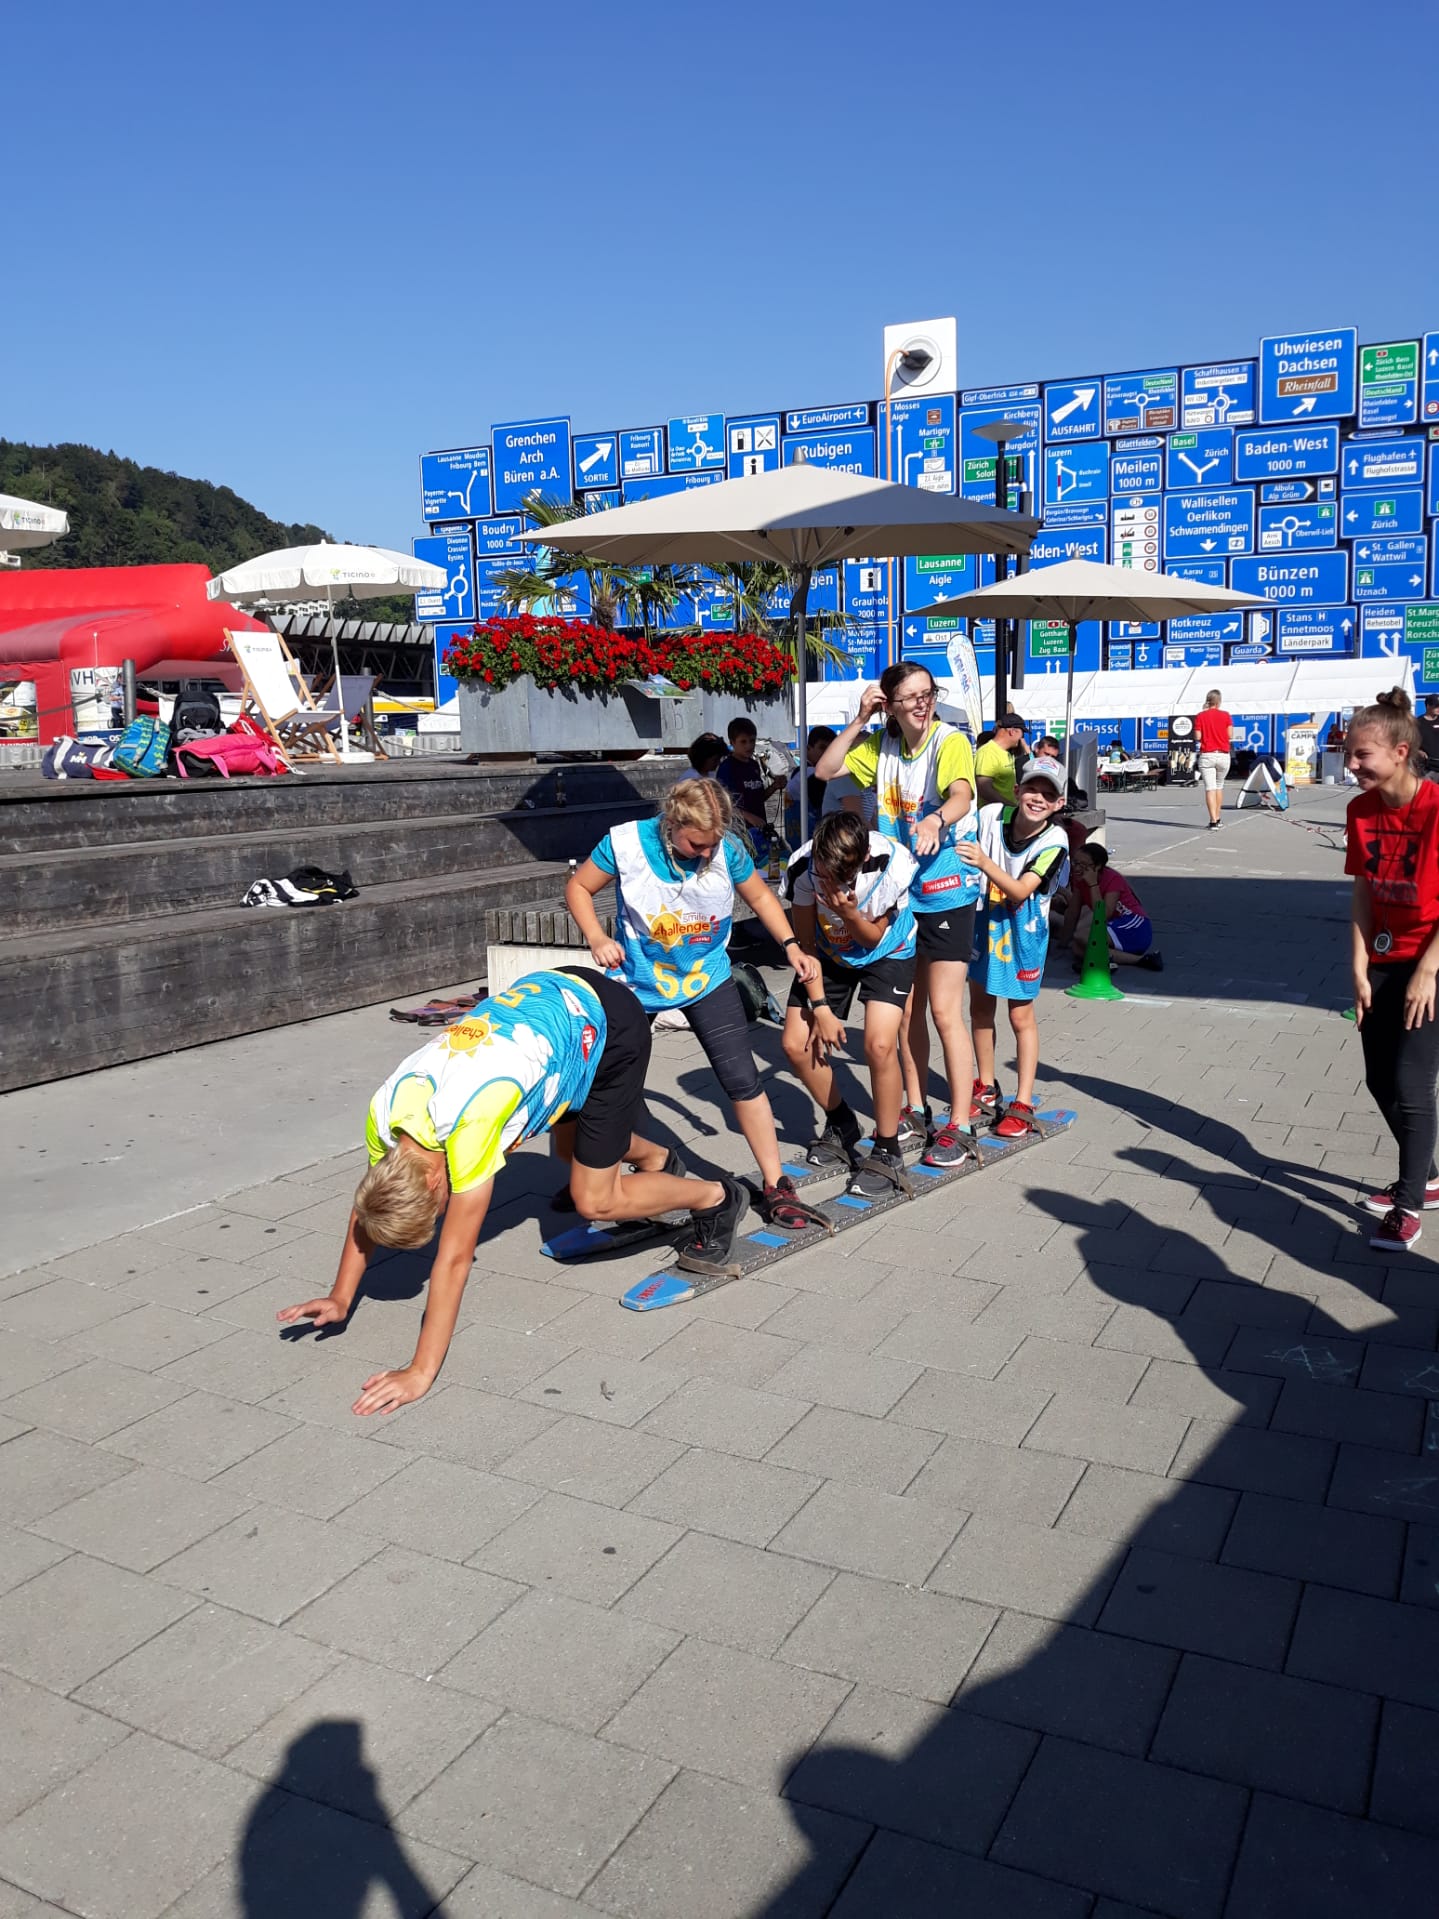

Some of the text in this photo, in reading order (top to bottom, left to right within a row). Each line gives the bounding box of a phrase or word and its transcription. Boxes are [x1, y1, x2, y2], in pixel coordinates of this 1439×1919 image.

[1274, 338, 1343, 356] Uhwiesen
[1278, 357, 1338, 373] Dachsen
[1194, 367, 1240, 377] Schaffhausen
[1284, 377, 1332, 393] Rheinfall
[894, 402, 920, 410] Mosses
[802, 412, 852, 425] EuroAirport
[891, 413, 909, 421] Aigle
[1004, 410, 1039, 420] Kirchberg
[918, 427, 951, 437] Martigny
[1051, 423, 1096, 436] AUSFAHRT
[505, 432, 556, 448] Grenchen
[1005, 440, 1037, 450] Burgdorf
[1118, 439, 1157, 449] Glattfelden
[1173, 437, 1195, 446] Basel
[1245, 437, 1328, 456] Baden-West
[519, 450, 544, 464] Arch
[1047, 449, 1073, 458] Luzern
[1204, 447, 1229, 458] Zürich
[1363, 452, 1407, 463] Flughafen
[967, 462, 989, 470] Zürich
[1115, 460, 1158, 475] Meilen
[1267, 459, 1306, 472] 1000 m
[1366, 464, 1415, 475] Flughofstrasse
[504, 467, 561, 484] Büren a.A.
[584, 473, 609, 483] SORTIE
[685, 473, 711, 485] Fribourg
[1119, 477, 1155, 488] 1000 m
[1181, 496, 1238, 509] Wallisellen
[1187, 511, 1231, 522] Oerlikon
[482, 524, 515, 536] Boudry
[1169, 522, 1249, 537] Schwamendingen
[1371, 520, 1398, 529] Zürich
[486, 540, 504, 549] 1000
[1372, 541, 1415, 551] St. Gallen
[1372, 551, 1407, 562] Wattwil
[919, 558, 962, 569] Lausanne
[1183, 568, 1203, 576] Aarau
[1258, 565, 1319, 582] Bünzen
[929, 575, 952, 586] Aigle
[1264, 586, 1313, 599] 1000 m
[1356, 586, 1387, 597] Uznach
[852, 595, 889, 607] Grauholz
[1286, 613, 1313, 622] Stans
[1365, 608, 1395, 617] Heiden
[929, 618, 957, 629] Luzern
[1171, 618, 1211, 628] Rotkreuz
[1171, 629, 1220, 640] Hünenberg
[1281, 624, 1334, 634] Ennetmoos
[1283, 637, 1330, 649] Länderpark
[848, 647, 876, 655] Monthey
[1039, 647, 1051, 655] Zug
[1234, 646, 1263, 655] Guarda
[653, 960, 711, 1000] 56
